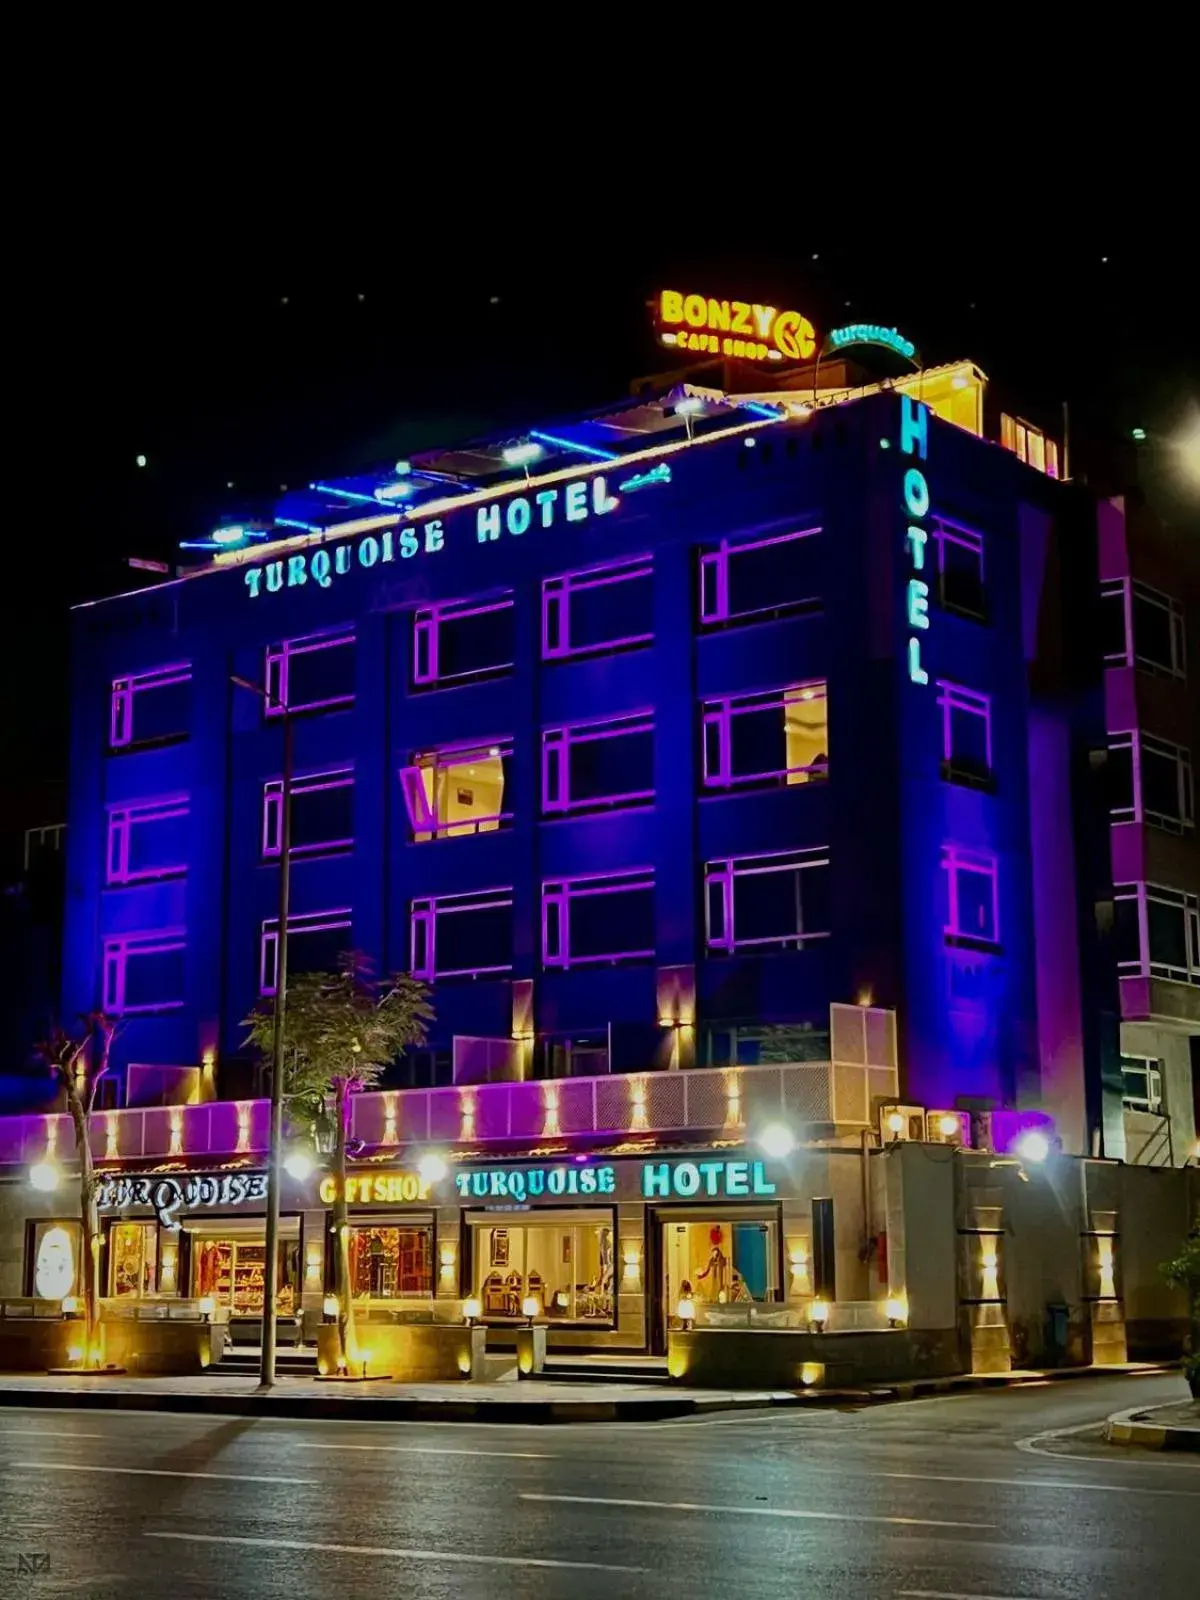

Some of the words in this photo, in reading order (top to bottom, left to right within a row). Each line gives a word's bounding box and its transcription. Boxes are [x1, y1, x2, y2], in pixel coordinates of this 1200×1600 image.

[661, 290, 776, 338] BONZY
[723, 338, 768, 360] SHOP
[243, 519, 445, 598] TURQUOISE
[477, 476, 620, 544] HOTEL
[900, 395, 929, 685] HOTEL
[319, 1174, 372, 1203] GFT
[456, 1166, 616, 1202] TURQUOISE
[643, 1161, 776, 1198] HOTEL
